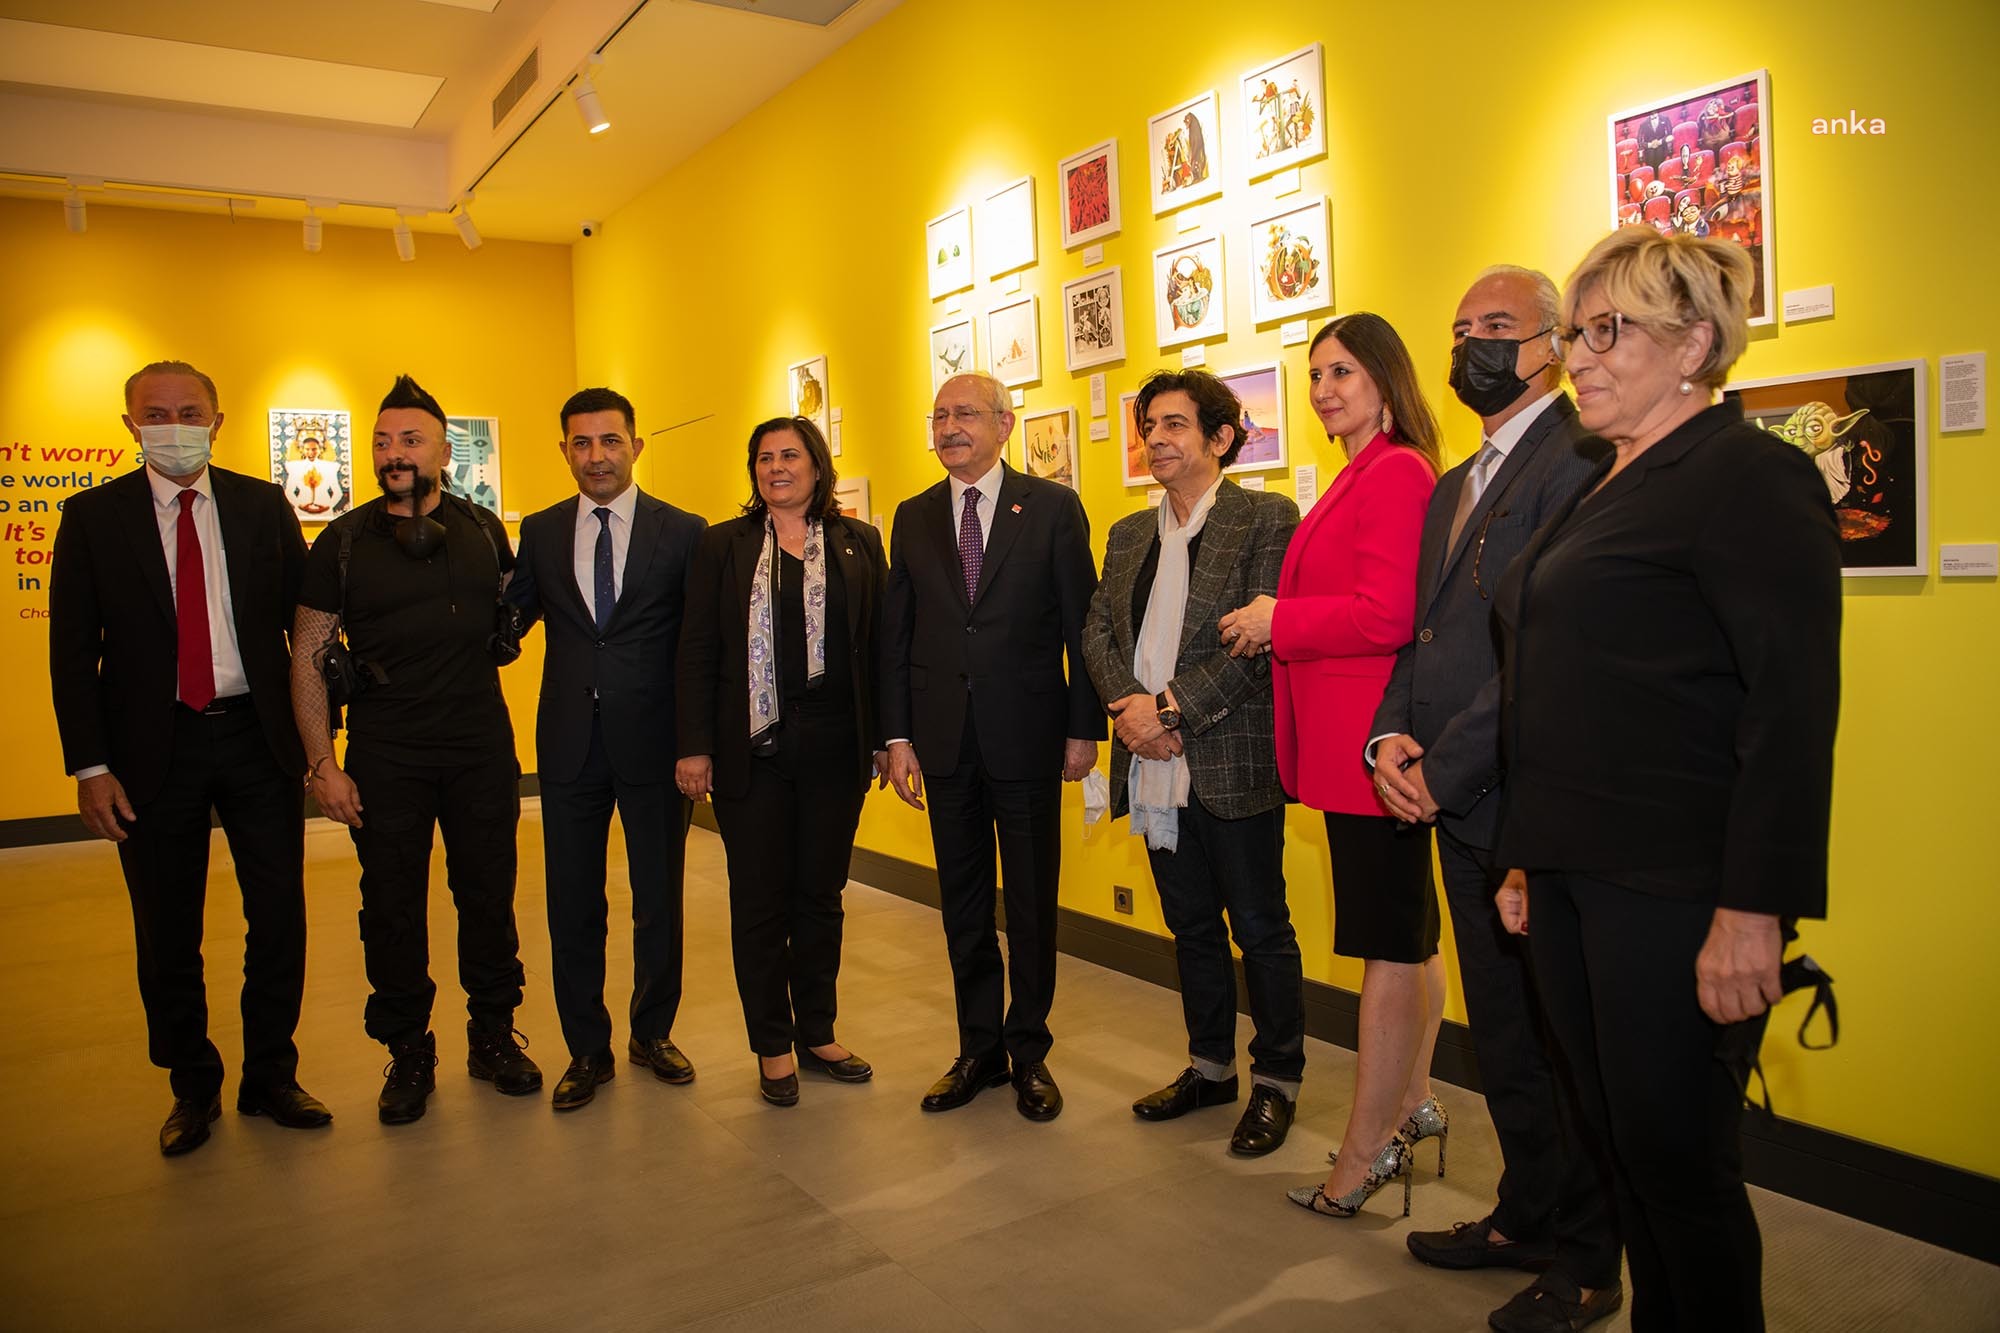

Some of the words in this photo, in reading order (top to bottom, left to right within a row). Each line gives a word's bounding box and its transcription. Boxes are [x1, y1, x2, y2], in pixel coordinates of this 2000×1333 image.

[41, 447, 125, 467] worry
[22, 472, 93, 488] world
[18, 500, 49, 513] an
[4, 521, 46, 542] It's
[18, 573, 41, 590] in
